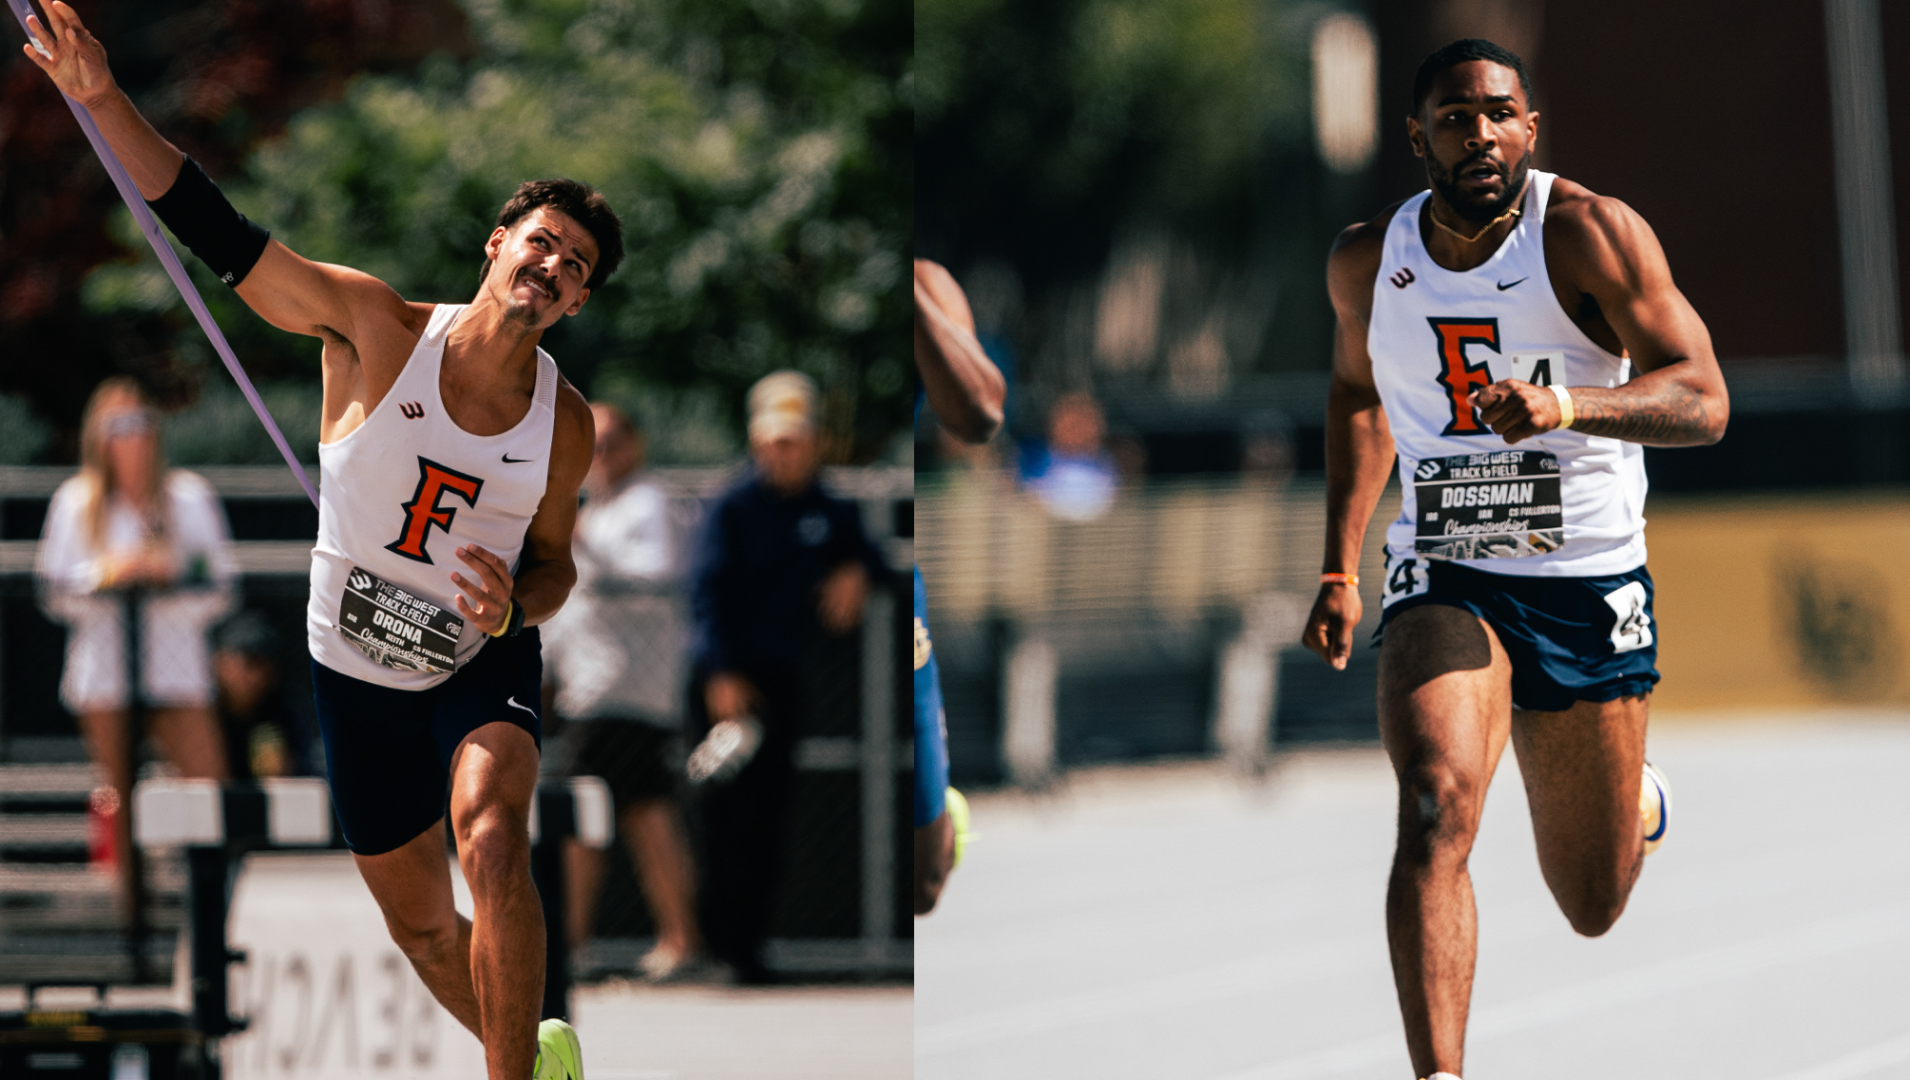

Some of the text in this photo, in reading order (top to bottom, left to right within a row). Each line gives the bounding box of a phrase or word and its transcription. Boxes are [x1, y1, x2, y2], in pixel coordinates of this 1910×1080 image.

[1425, 316, 1502, 437] F
[1445, 457, 1467, 467] THE
[1490, 451, 1525, 464] WEST
[1450, 464, 1519, 479] TRACK & FIELD
[384, 455, 485, 565] F
[1441, 482, 1534, 508] DOSSMAN
[1444, 518, 1530, 536] Championships
[1478, 509, 1493, 519] IAN
[1389, 559, 1419, 594] 4
[375, 579, 396, 597] THE
[412, 596, 441, 617] WEST
[375, 592, 430, 625] TRACK & FIELD
[373, 610, 422, 644] ORONA
[1620, 595, 1643, 645] 4
[360, 627, 429, 664] Championships
[386, 633, 405, 646] KEITH
[422, 648, 454, 664] FULLERTON
